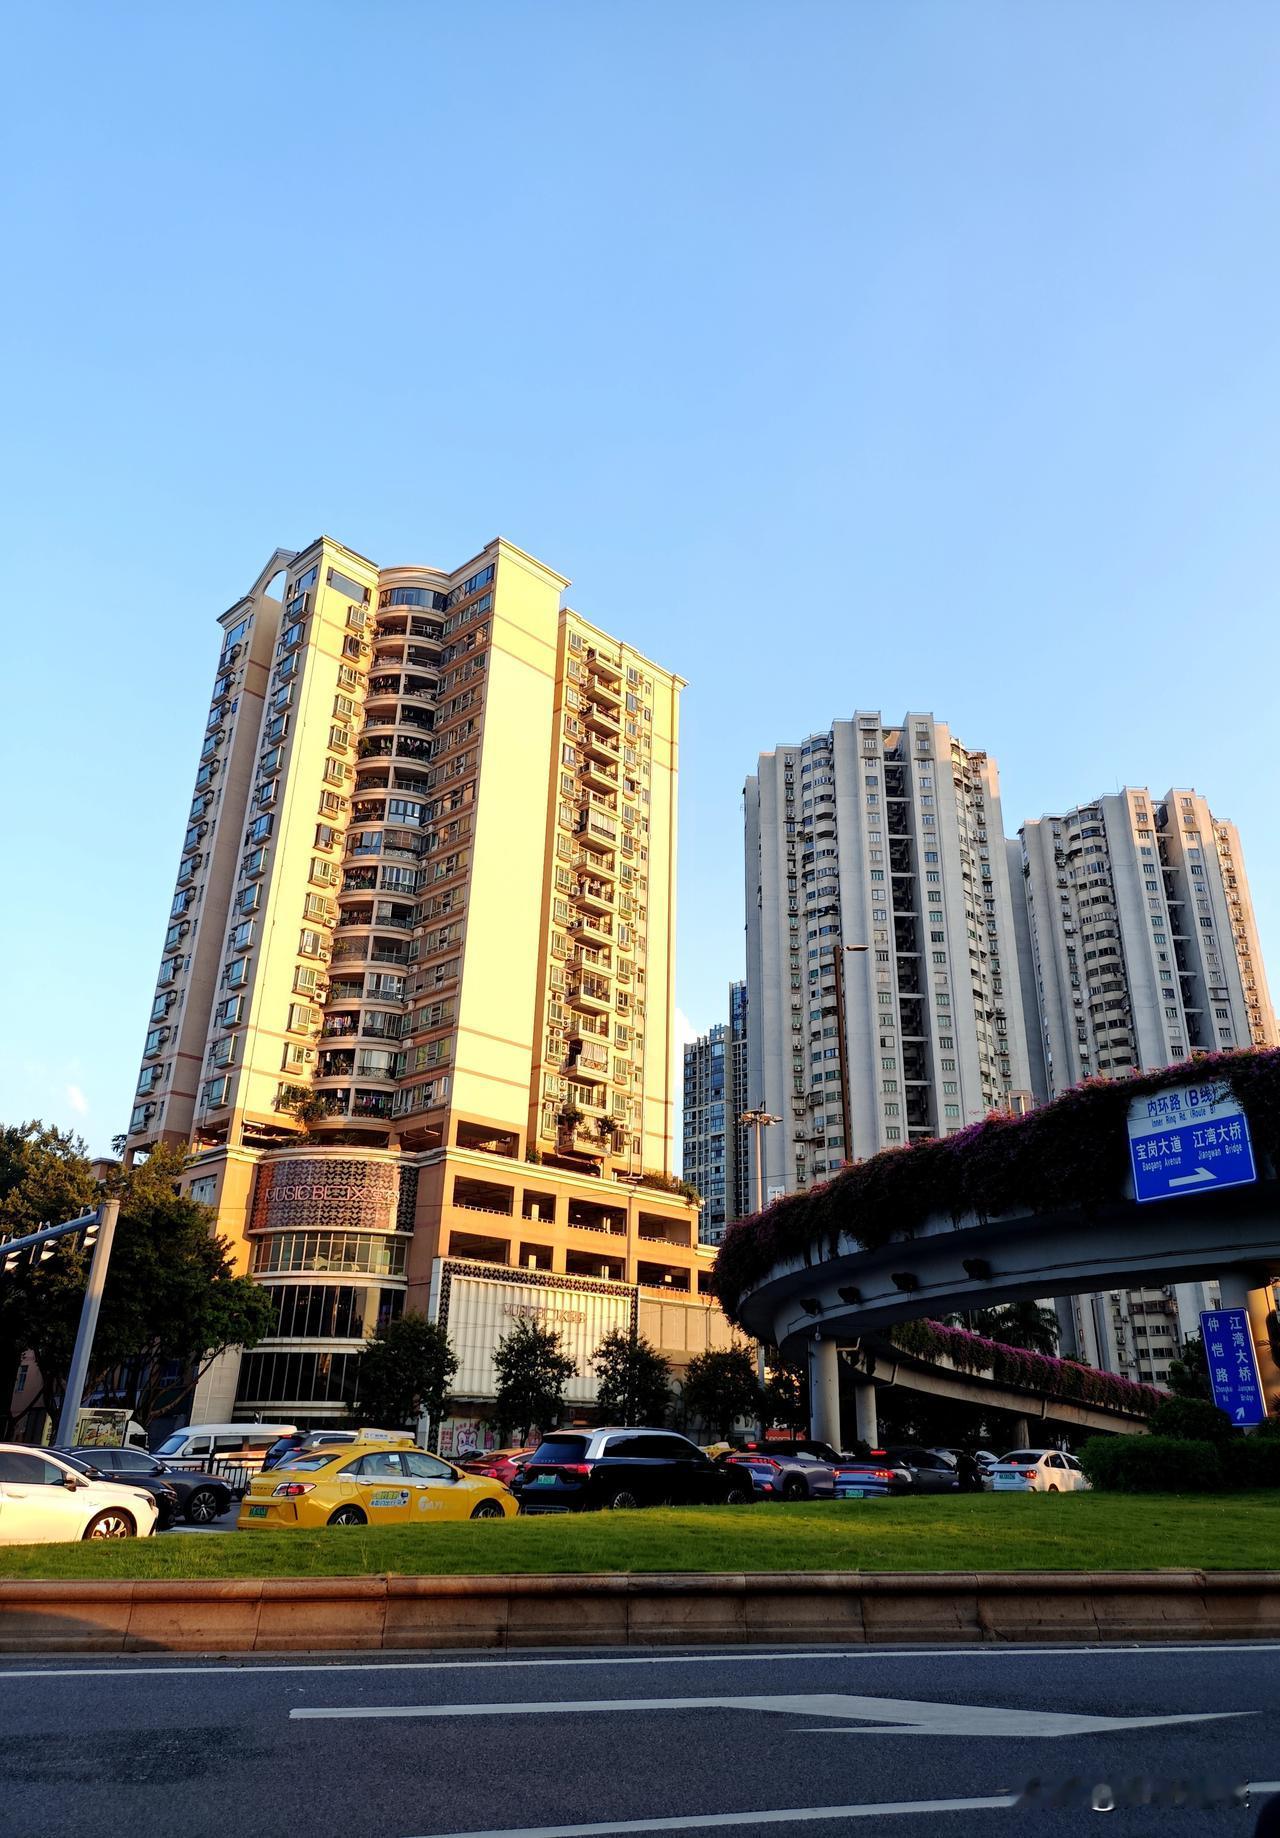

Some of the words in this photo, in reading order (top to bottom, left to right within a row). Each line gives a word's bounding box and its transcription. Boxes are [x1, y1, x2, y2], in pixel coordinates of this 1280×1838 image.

[1151, 1117, 1163, 1128] Inner
[1165, 1114, 1177, 1125] Ring
[1192, 1121, 1242, 1149] 江湾大桥
[1136, 1136, 1182, 1161] 宝岗大道
[1198, 1148, 1221, 1161] Jiangwan
[1225, 1143, 1243, 1155] Bridge
[1142, 1159, 1162, 1172] Baogang
[1164, 1156, 1182, 1168] Avenue
[265, 1186, 310, 1201] MUSIC
[313, 1185, 366, 1201] BOX
[1208, 1318, 1228, 1382] 仲恺路
[1230, 1317, 1251, 1382] 江湾大桥
